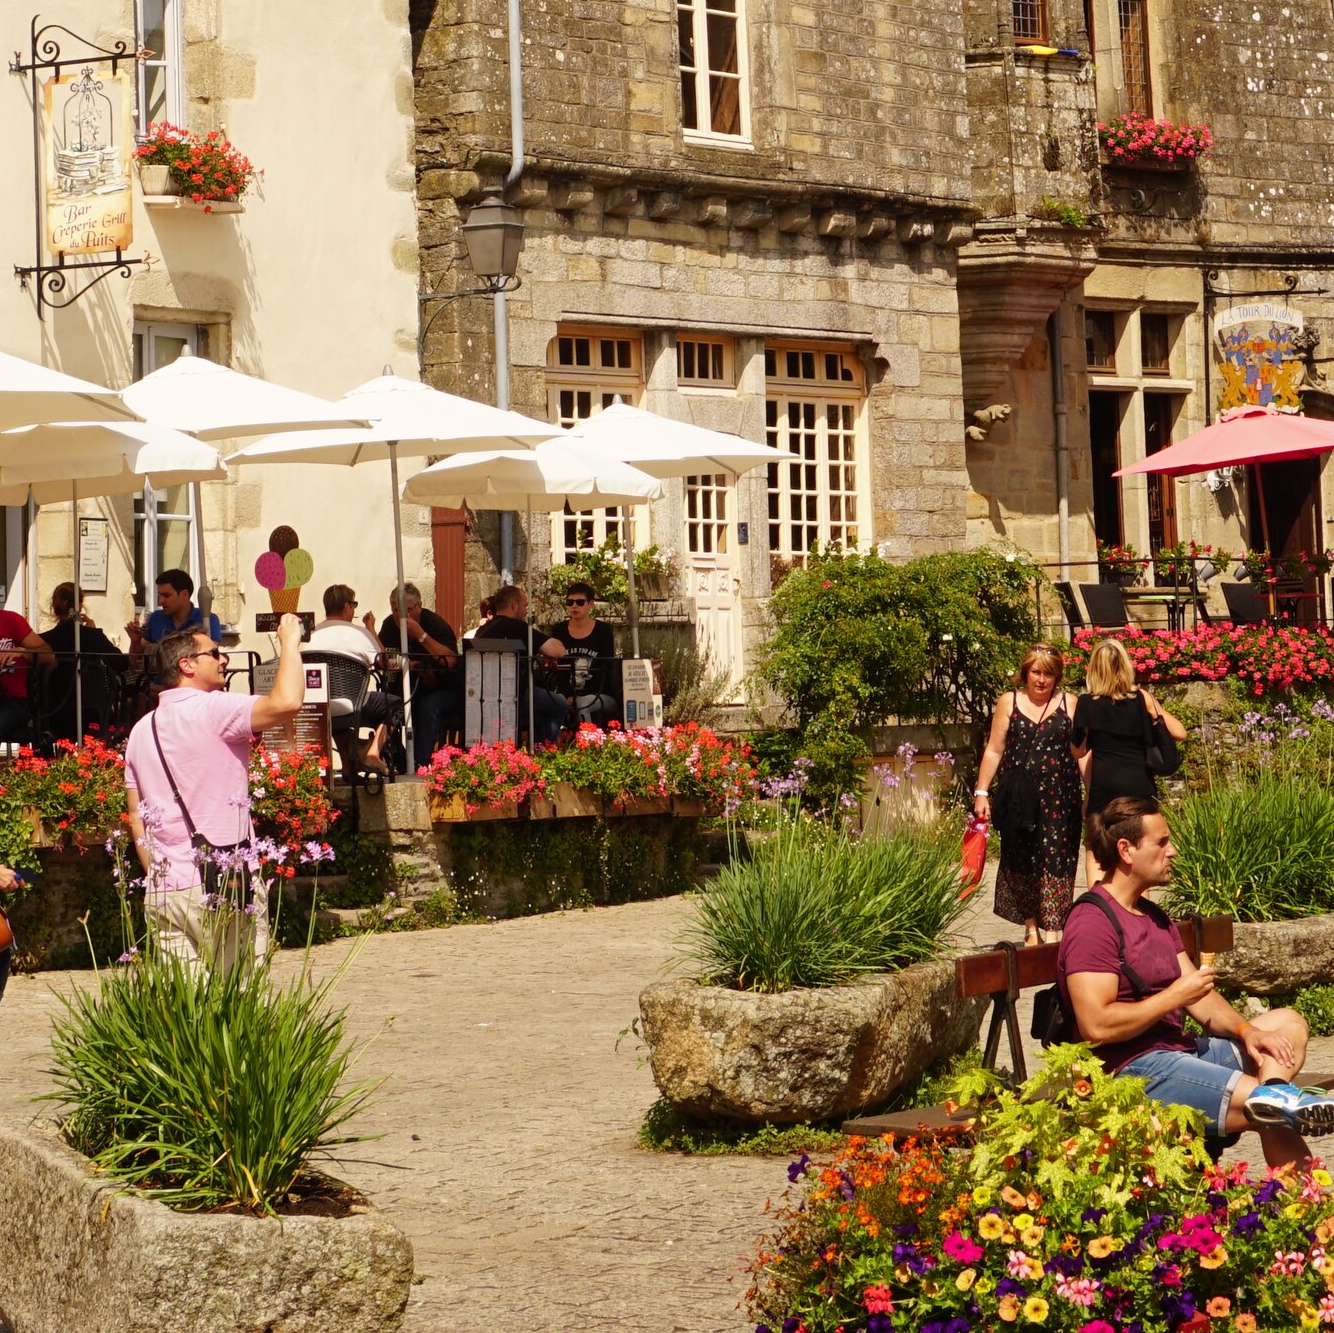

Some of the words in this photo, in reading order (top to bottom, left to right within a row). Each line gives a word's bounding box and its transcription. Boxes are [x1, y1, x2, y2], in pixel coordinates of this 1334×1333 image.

[64, 205, 92, 224] Bar
[102, 212, 127, 228] Grill
[70, 239, 80, 248] du
[81, 230, 115, 248] Puits
[1221, 311, 1234, 325] LA
[1237, 305, 1260, 318] TOUR
[1264, 304, 1274, 317] DU
